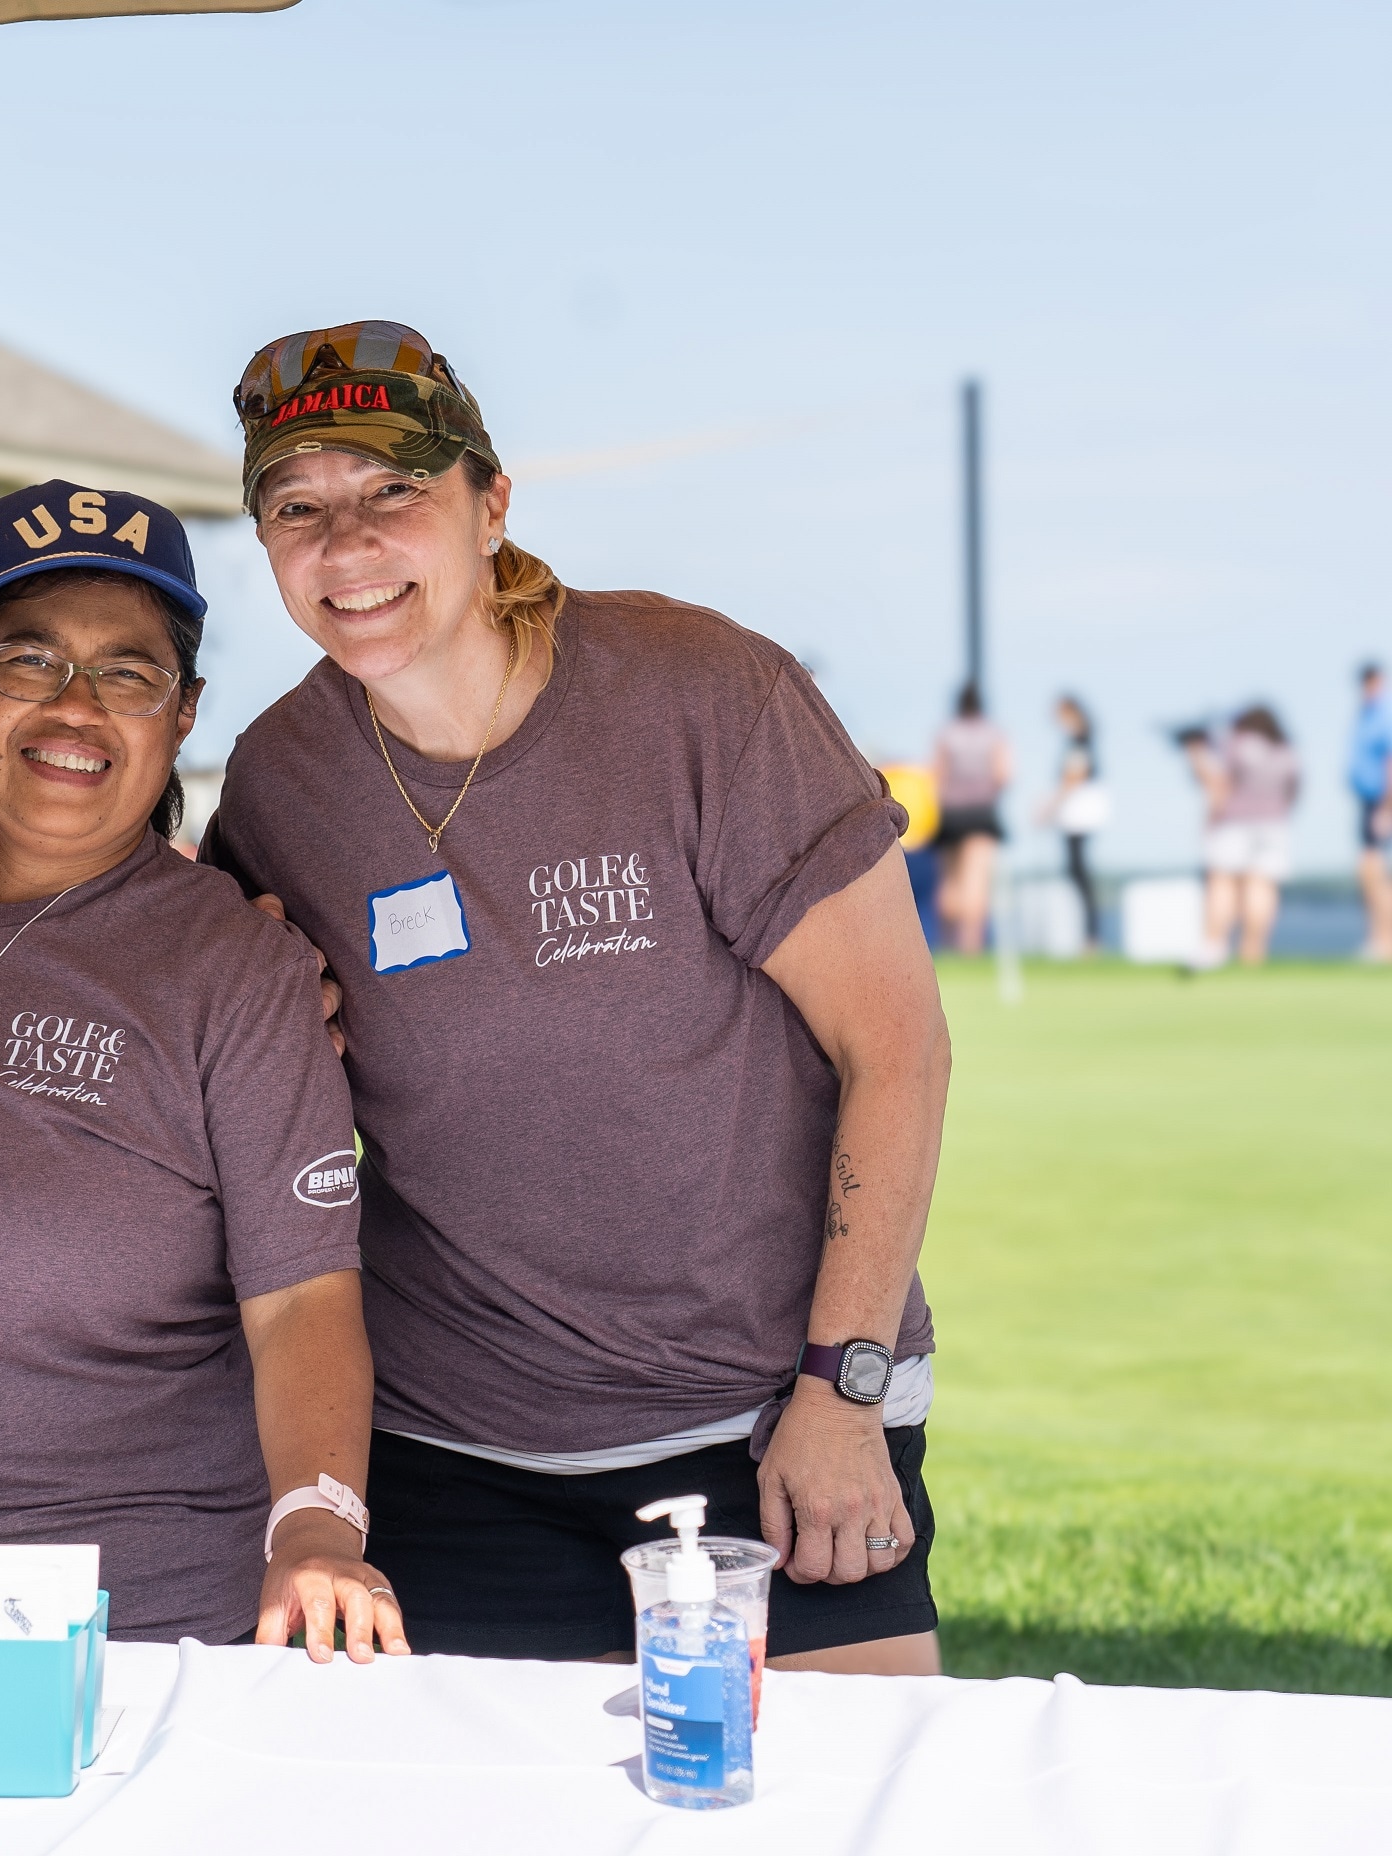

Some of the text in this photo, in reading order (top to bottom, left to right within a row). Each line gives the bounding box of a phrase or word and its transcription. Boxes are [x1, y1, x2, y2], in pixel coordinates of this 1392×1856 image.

[271, 384, 391, 428] JAMAICA
[12, 491, 150, 555] USA
[528, 853, 651, 898] GOLF&
[531, 887, 654, 934] TASTE
[535, 927, 657, 968] Celebration
[11, 1011, 127, 1056] GOLF&
[3, 1038, 120, 1083] TASTE
[307, 1185, 341, 1195] PROPERTY
